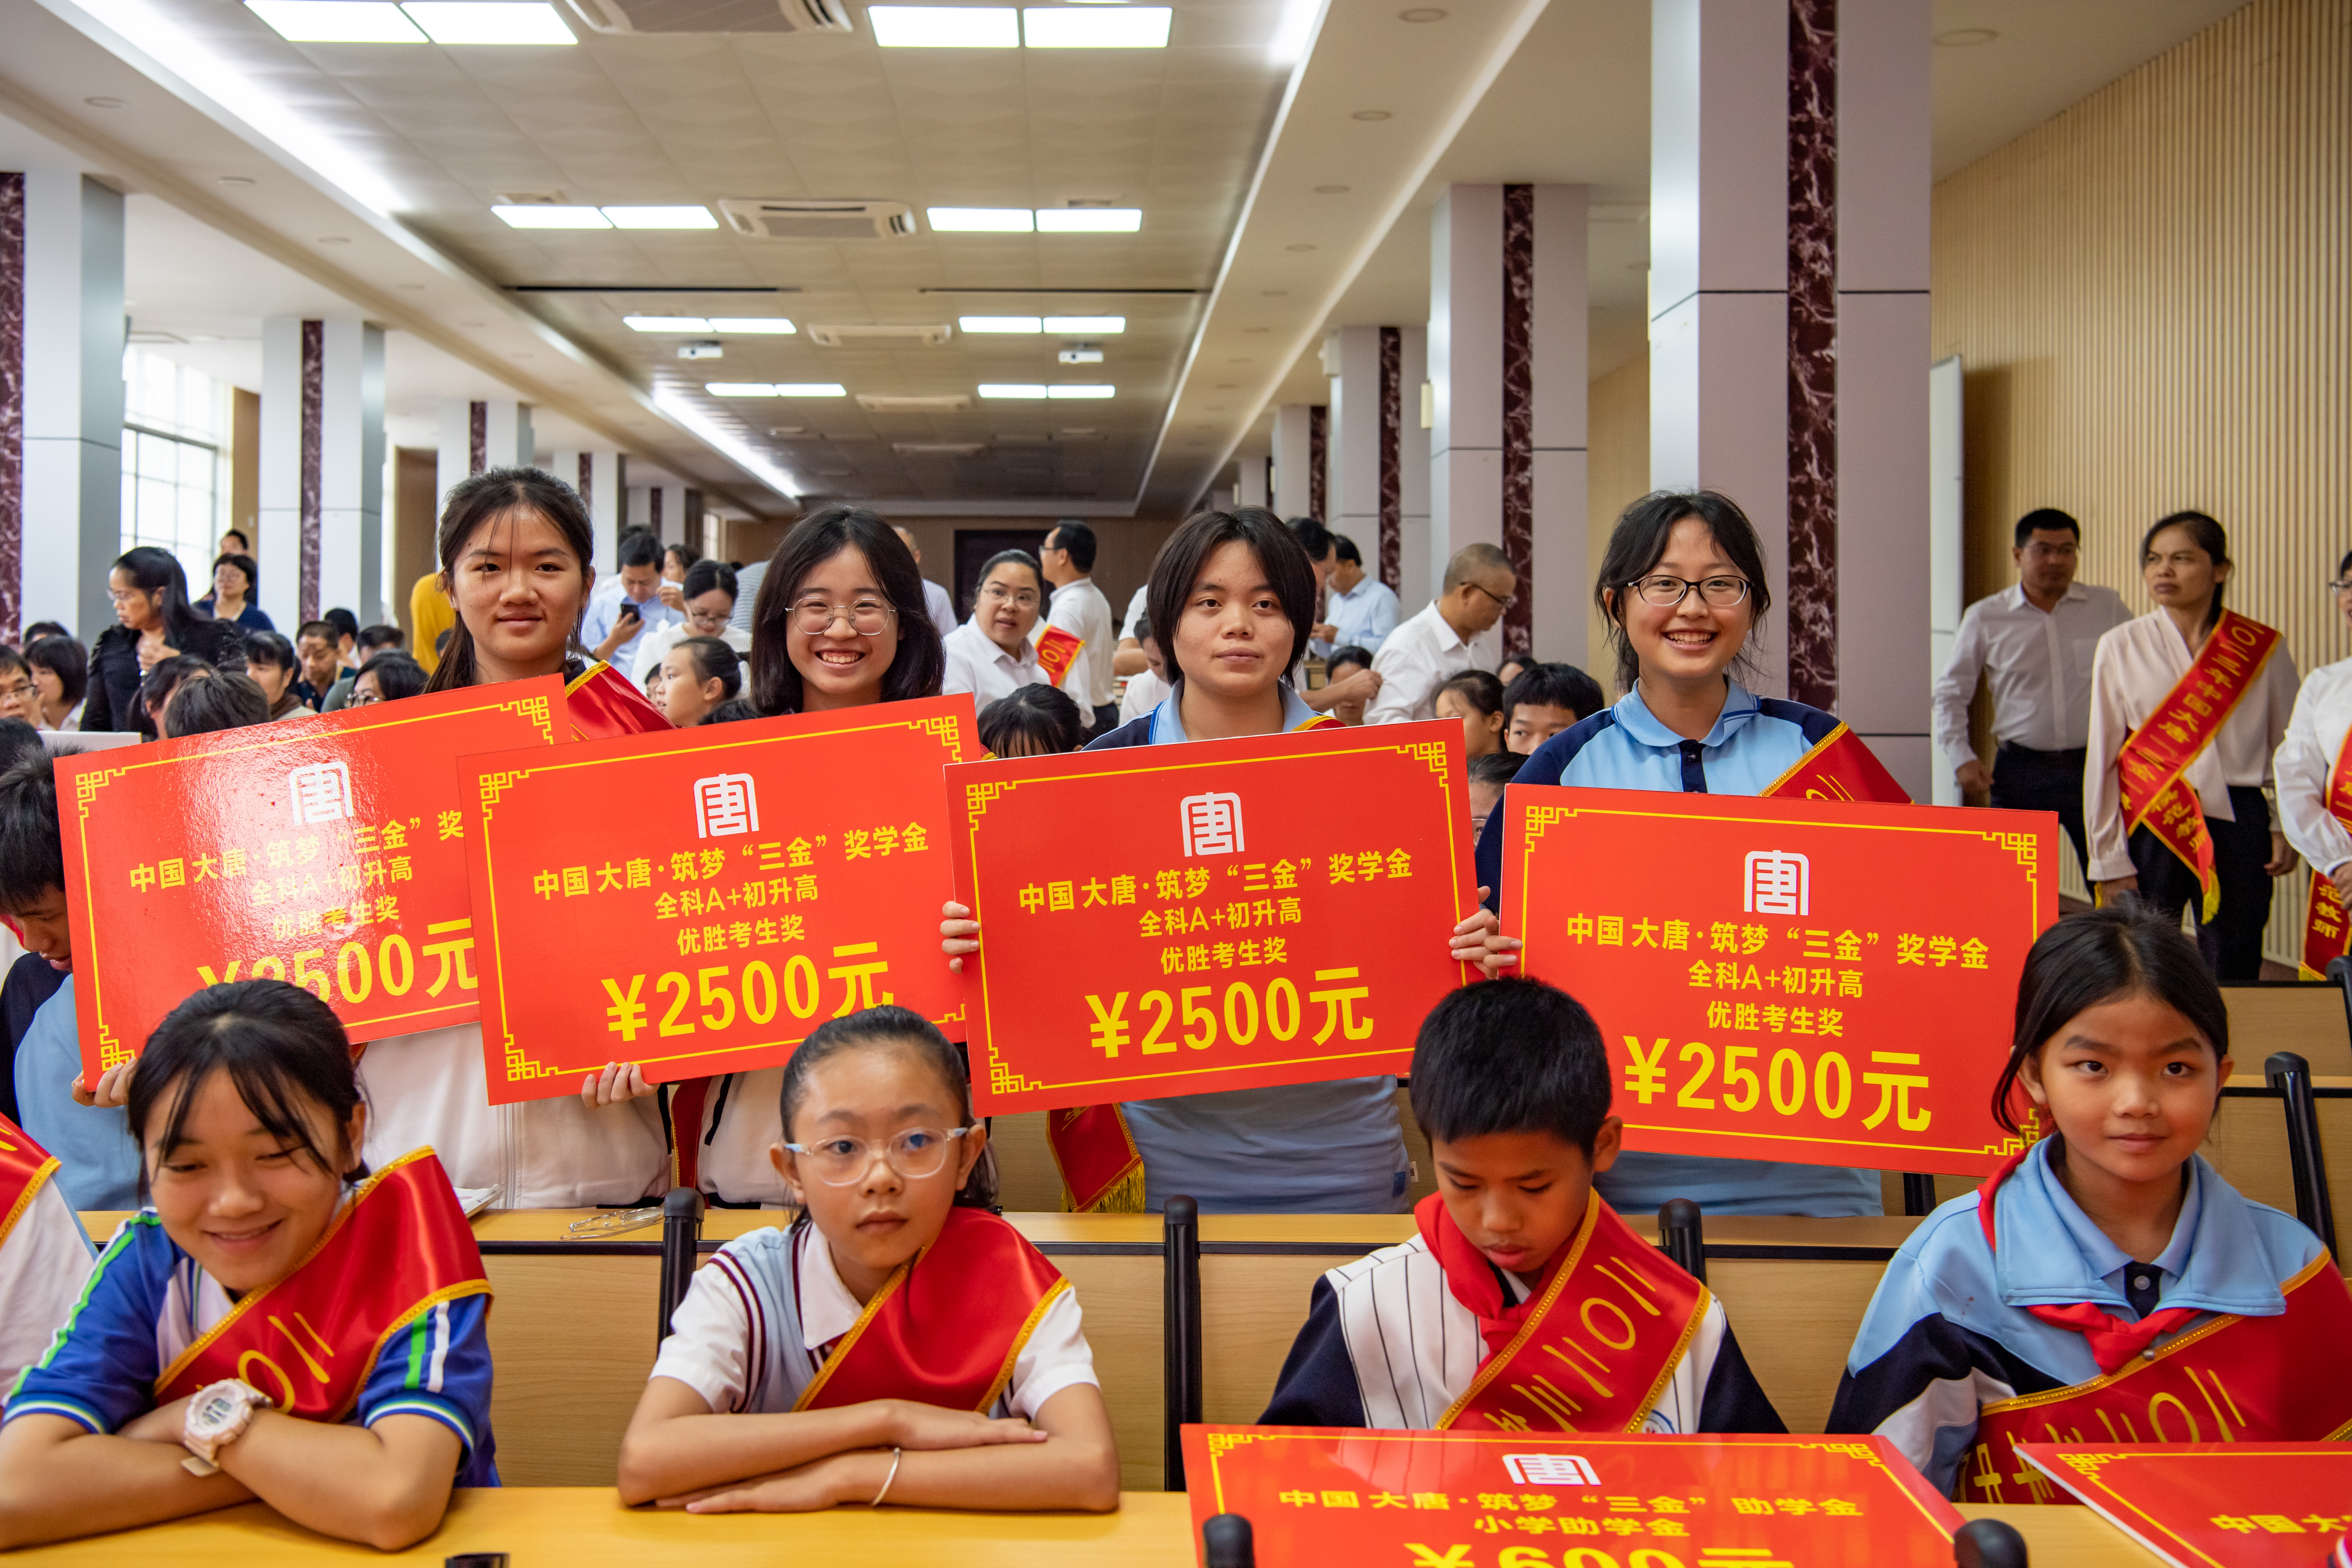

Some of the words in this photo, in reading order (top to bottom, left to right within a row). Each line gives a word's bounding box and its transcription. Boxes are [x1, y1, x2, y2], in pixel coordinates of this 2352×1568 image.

[250, 855, 413, 906] 全科A+初升高
[654, 874, 819, 920] 全科A+初升高
[272, 894, 400, 941] 优胜考生奖
[677, 914, 806, 956] 优胜考生奖
[1139, 896, 1301, 937] 全科A+初升高
[1160, 936, 1288, 975] 优胜考生奖
[600, 942, 894, 1042] ¥2500元
[1688, 959, 1864, 998] 全科A+初升高
[1084, 966, 1374, 1058] ¥2500元
[1707, 1000, 1843, 1037] 优胜考生奖
[1622, 1035, 1932, 1132] ¥2500元
[1473, 1515, 1690, 1537] 小学助学金
[2209, 1514, 2352, 1534] 中国大
